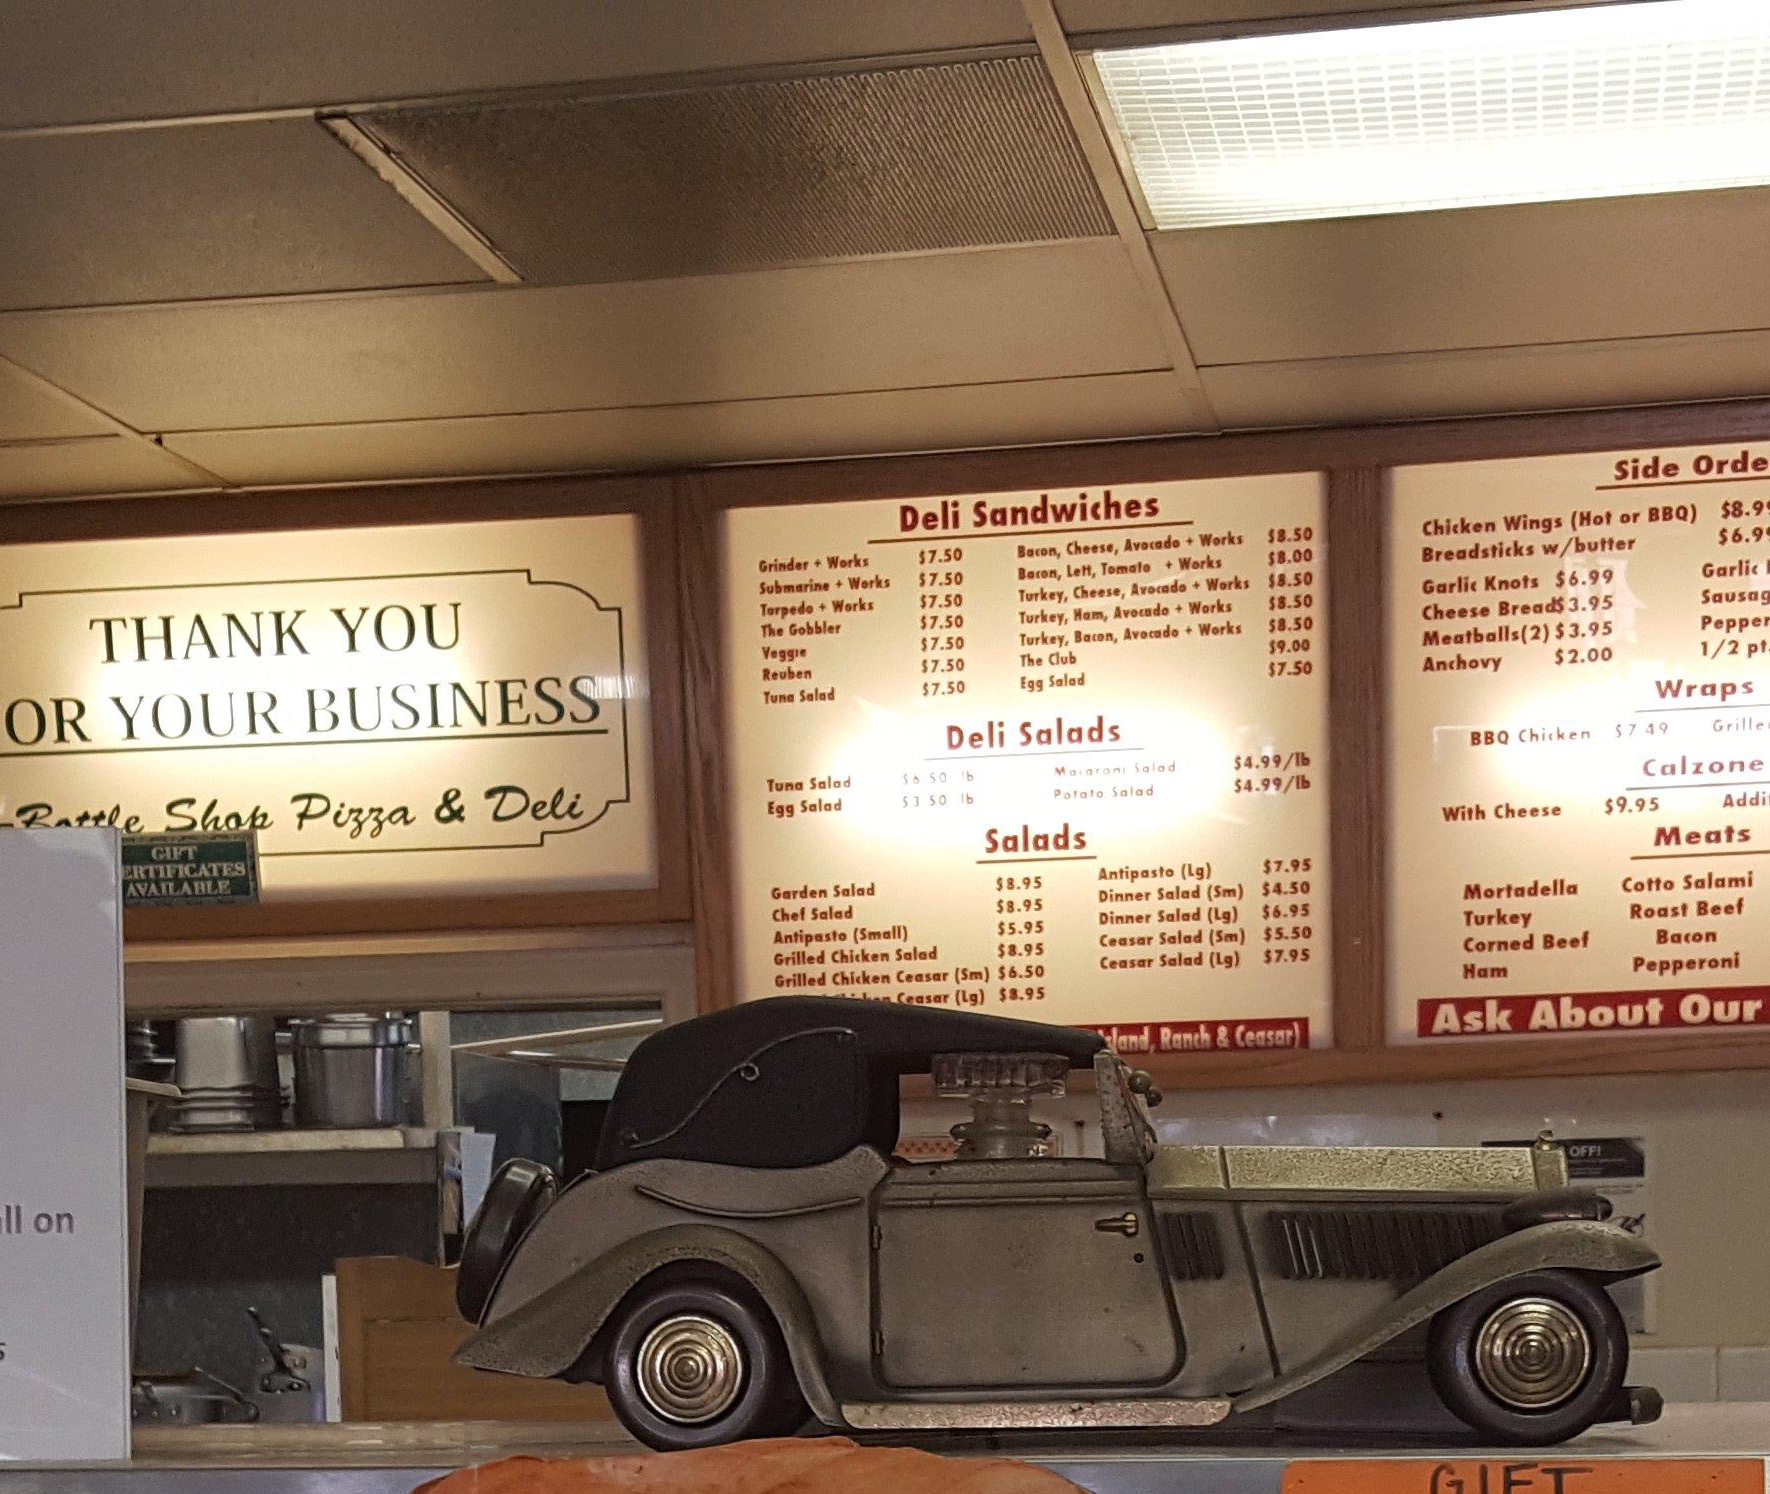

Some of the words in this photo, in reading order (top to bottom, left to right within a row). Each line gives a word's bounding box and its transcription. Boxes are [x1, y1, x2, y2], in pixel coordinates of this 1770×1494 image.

[1615, 456, 1679, 480] Side
[900, 501, 959, 532] Deli
[973, 490, 1158, 527] Sandwiches
[1423, 517, 1495, 536] Chicken
[1503, 514, 1562, 533] Wings
[1571, 511, 1612, 531] (Hot
[1620, 512, 1640, 524] or
[1648, 504, 1696, 524] BBQ)
[759, 557, 808, 573] Grinder
[814, 559, 821, 567] +
[827, 554, 868, 569] Works
[919, 548, 962, 565] $7.50
[89, 610, 309, 663] THANK
[330, 602, 462, 652] YOU
[1655, 679, 1753, 702] Wraps
[110, 692, 281, 740] YOUR
[307, 676, 601, 735] BUSINESS
[947, 721, 1004, 750] Deli
[1020, 715, 1120, 746] Salads
[1643, 756, 1764, 776] Calzone
[165, 799, 273, 834] Shop
[292, 791, 413, 838] Pizza
[435, 789, 464, 822] &
[485, 785, 584, 822] Deli
[986, 823, 1086, 853] Salads
[1654, 826, 1751, 846] Meats
[151, 846, 197, 860] GIFT
[122, 862, 246, 878] ERTIFICATES
[126, 880, 231, 897] AVAILABLE
[1432, 1000, 1513, 1033] Ask
[1528, 993, 1664, 1031] About
[1679, 991, 1763, 1025] Our
[1160, 1025, 1211, 1052] Ranch
[1217, 1025, 1229, 1047] &
[1236, 1022, 1299, 1048] Ceasar)
[34, 1213, 74, 1233] on
